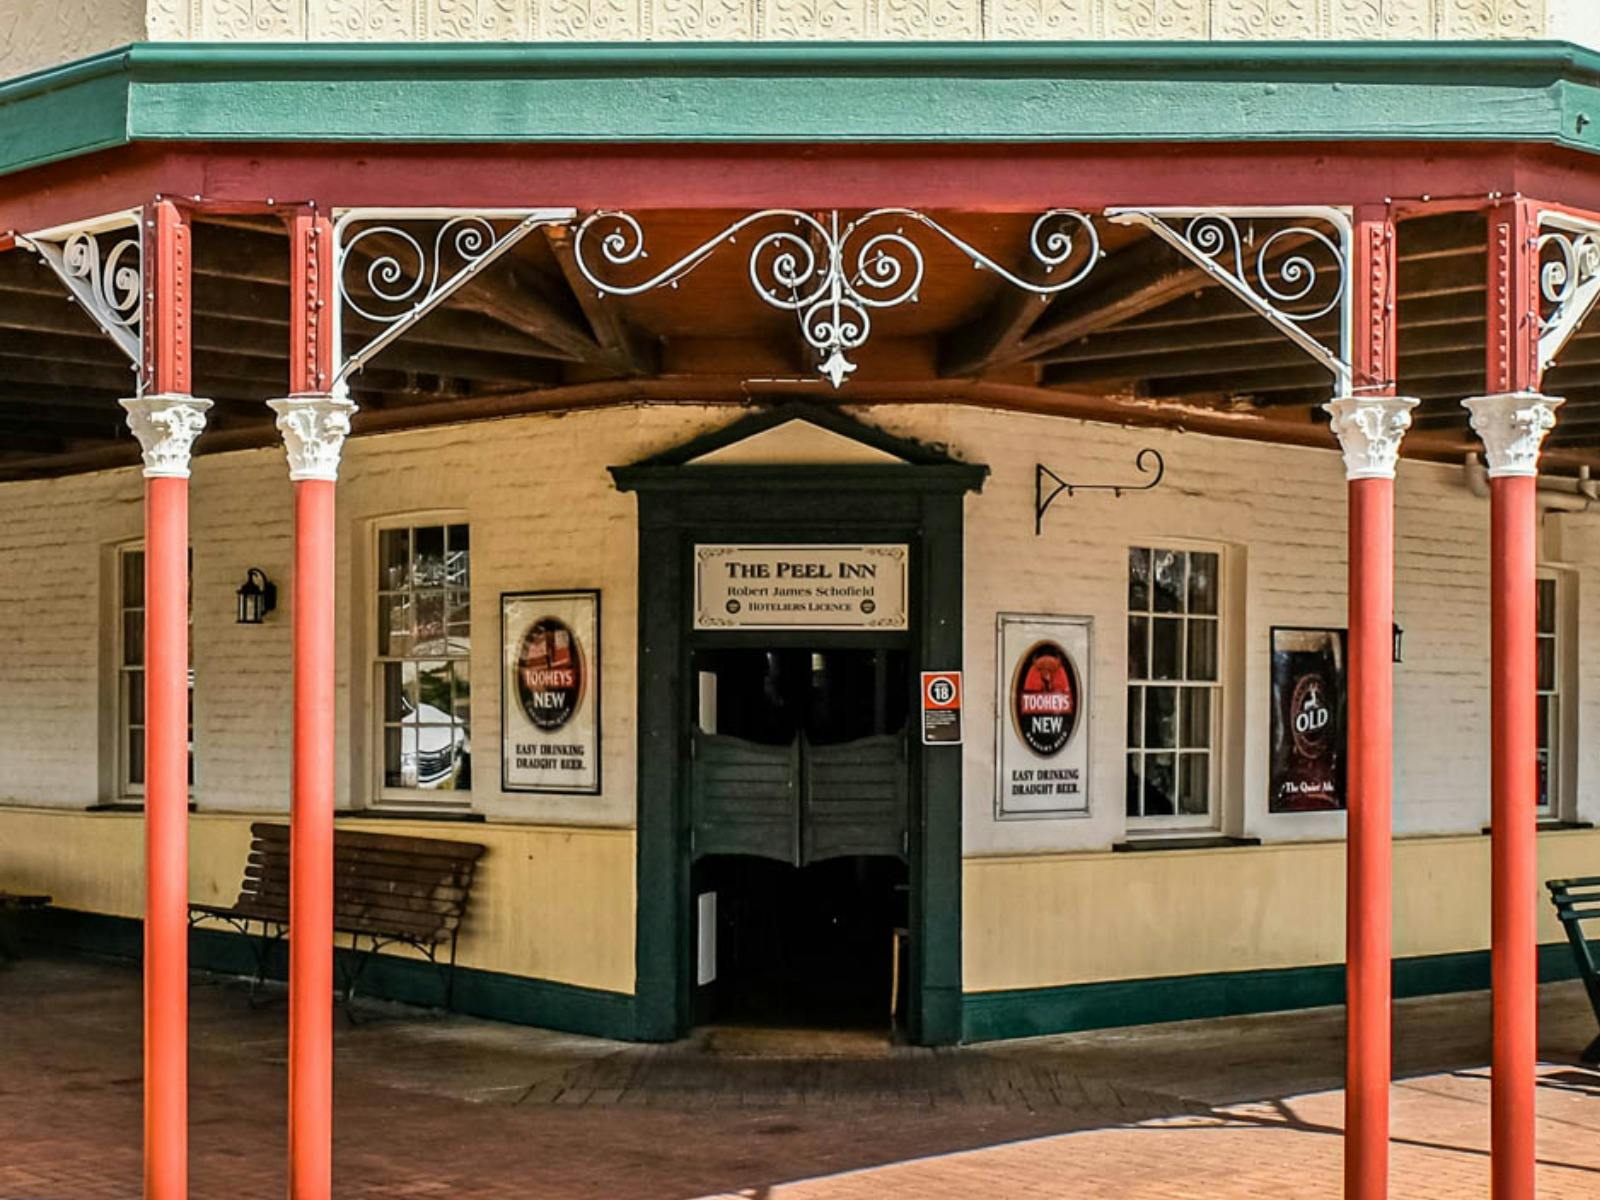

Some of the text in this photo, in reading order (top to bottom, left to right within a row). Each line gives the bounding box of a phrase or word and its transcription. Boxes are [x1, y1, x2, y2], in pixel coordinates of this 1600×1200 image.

[725, 562, 877, 579] THE PEEL INN
[727, 586, 874, 597] Robert James Schofield
[749, 602, 851, 612] HOTELIERS LICENCE
[525, 669, 573, 687] TOOHEYS
[533, 691, 566, 708] NEW
[934, 687, 949, 700] 18
[1022, 693, 1071, 711] TOOHEYS
[1031, 716, 1063, 733] NEW
[1295, 708, 1328, 732] OLD
[516, 744, 584, 756] EASY DRINKING
[516, 758, 557, 770] DRAUGHT
[1012, 769, 1079, 782] EASY DRINKING
[1012, 783, 1054, 795] DRAUGHT
